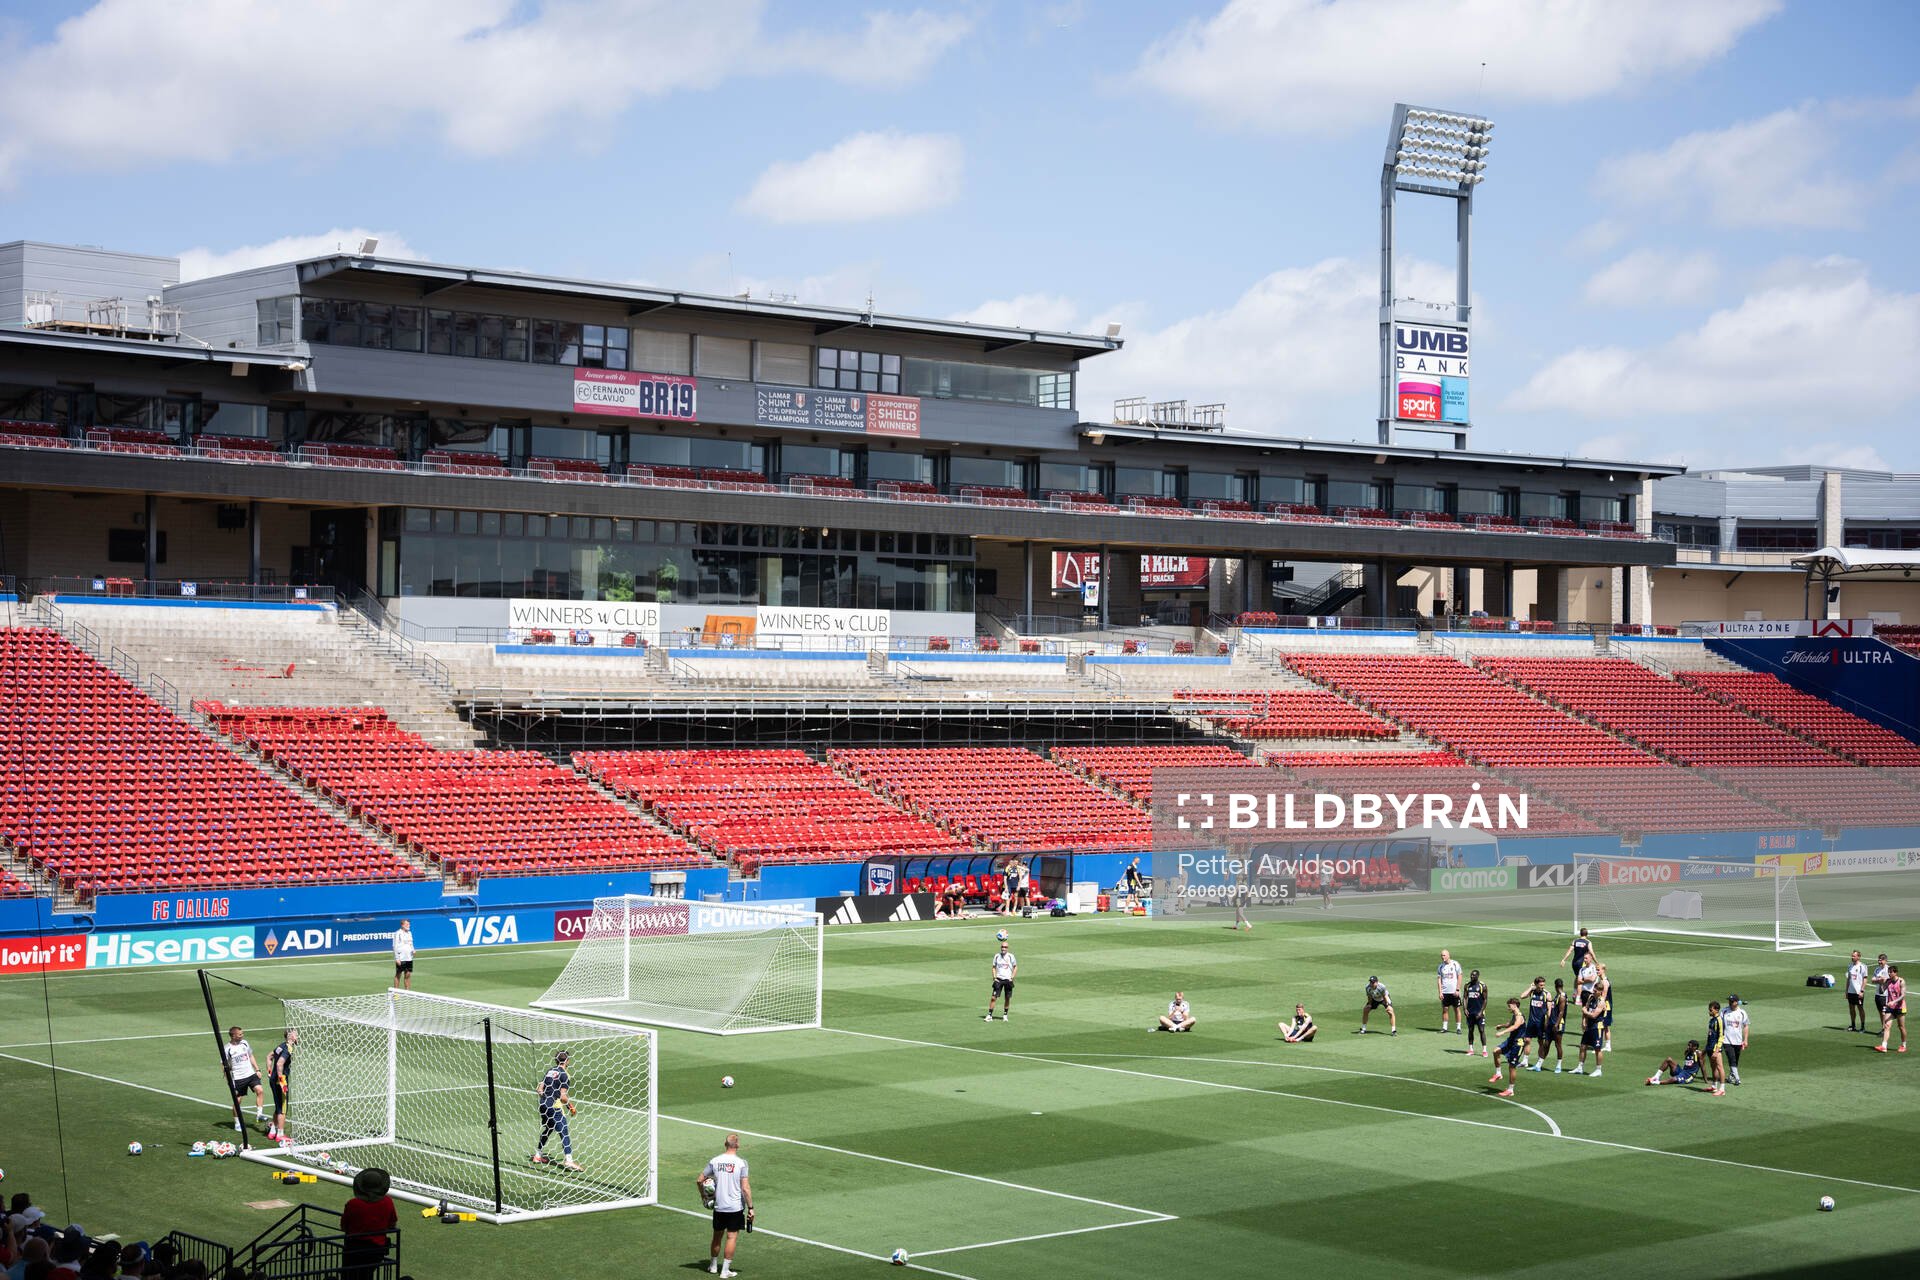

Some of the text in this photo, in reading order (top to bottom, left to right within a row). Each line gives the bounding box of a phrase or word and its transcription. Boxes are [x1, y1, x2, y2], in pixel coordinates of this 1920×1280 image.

[1397, 328, 1468, 353] UMB
[1396, 356, 1467, 375] BANK
[578, 386, 589, 397] FC
[592, 385, 636, 396] FERNANDO
[592, 393, 625, 403] CLAVIJO
[639, 380, 693, 418] BR19
[768, 391, 791, 400] LAMAR
[758, 391, 767, 420] 1997
[768, 399, 791, 408] HUNT
[824, 396, 846, 404] LAMAR
[824, 404, 846, 412] HUNT
[877, 400, 918, 410] SUPPORTERS'
[1403, 395, 1436, 415] spark
[768, 414, 809, 424] CHAMPIONS
[815, 396, 823, 425] 2016
[836, 412, 852, 420] OPEN
[868, 400, 876, 428] 2016
[878, 409, 917, 421] SHIELD
[824, 418, 865, 428] CHAMPIONS
[878, 420, 917, 432] WINNERS
[1152, 554, 1189, 573] KICK
[182, 586, 195, 595] 108
[513, 606, 593, 625] WINNERS
[614, 608, 657, 626] CLUB
[760, 612, 831, 631] WINNERS
[848, 614, 888, 632] CLUB
[1725, 623, 1755, 633] ULTRA
[1758, 623, 1790, 632] ZONE
[1782, 649, 1893, 664] Michelob ULTRA
[1827, 856, 1888, 867] BANK OF AMERICA
[1440, 869, 1508, 890] aramco
[1608, 863, 1672, 884] Lenovo
[152, 898, 229, 921] FC DALLAS
[449, 915, 519, 946] VISA
[557, 911, 687, 936] QATAR AIRWAYS
[281, 928, 397, 951] ADI PREDICTSTREE
[86, 932, 255, 968] Hisense
